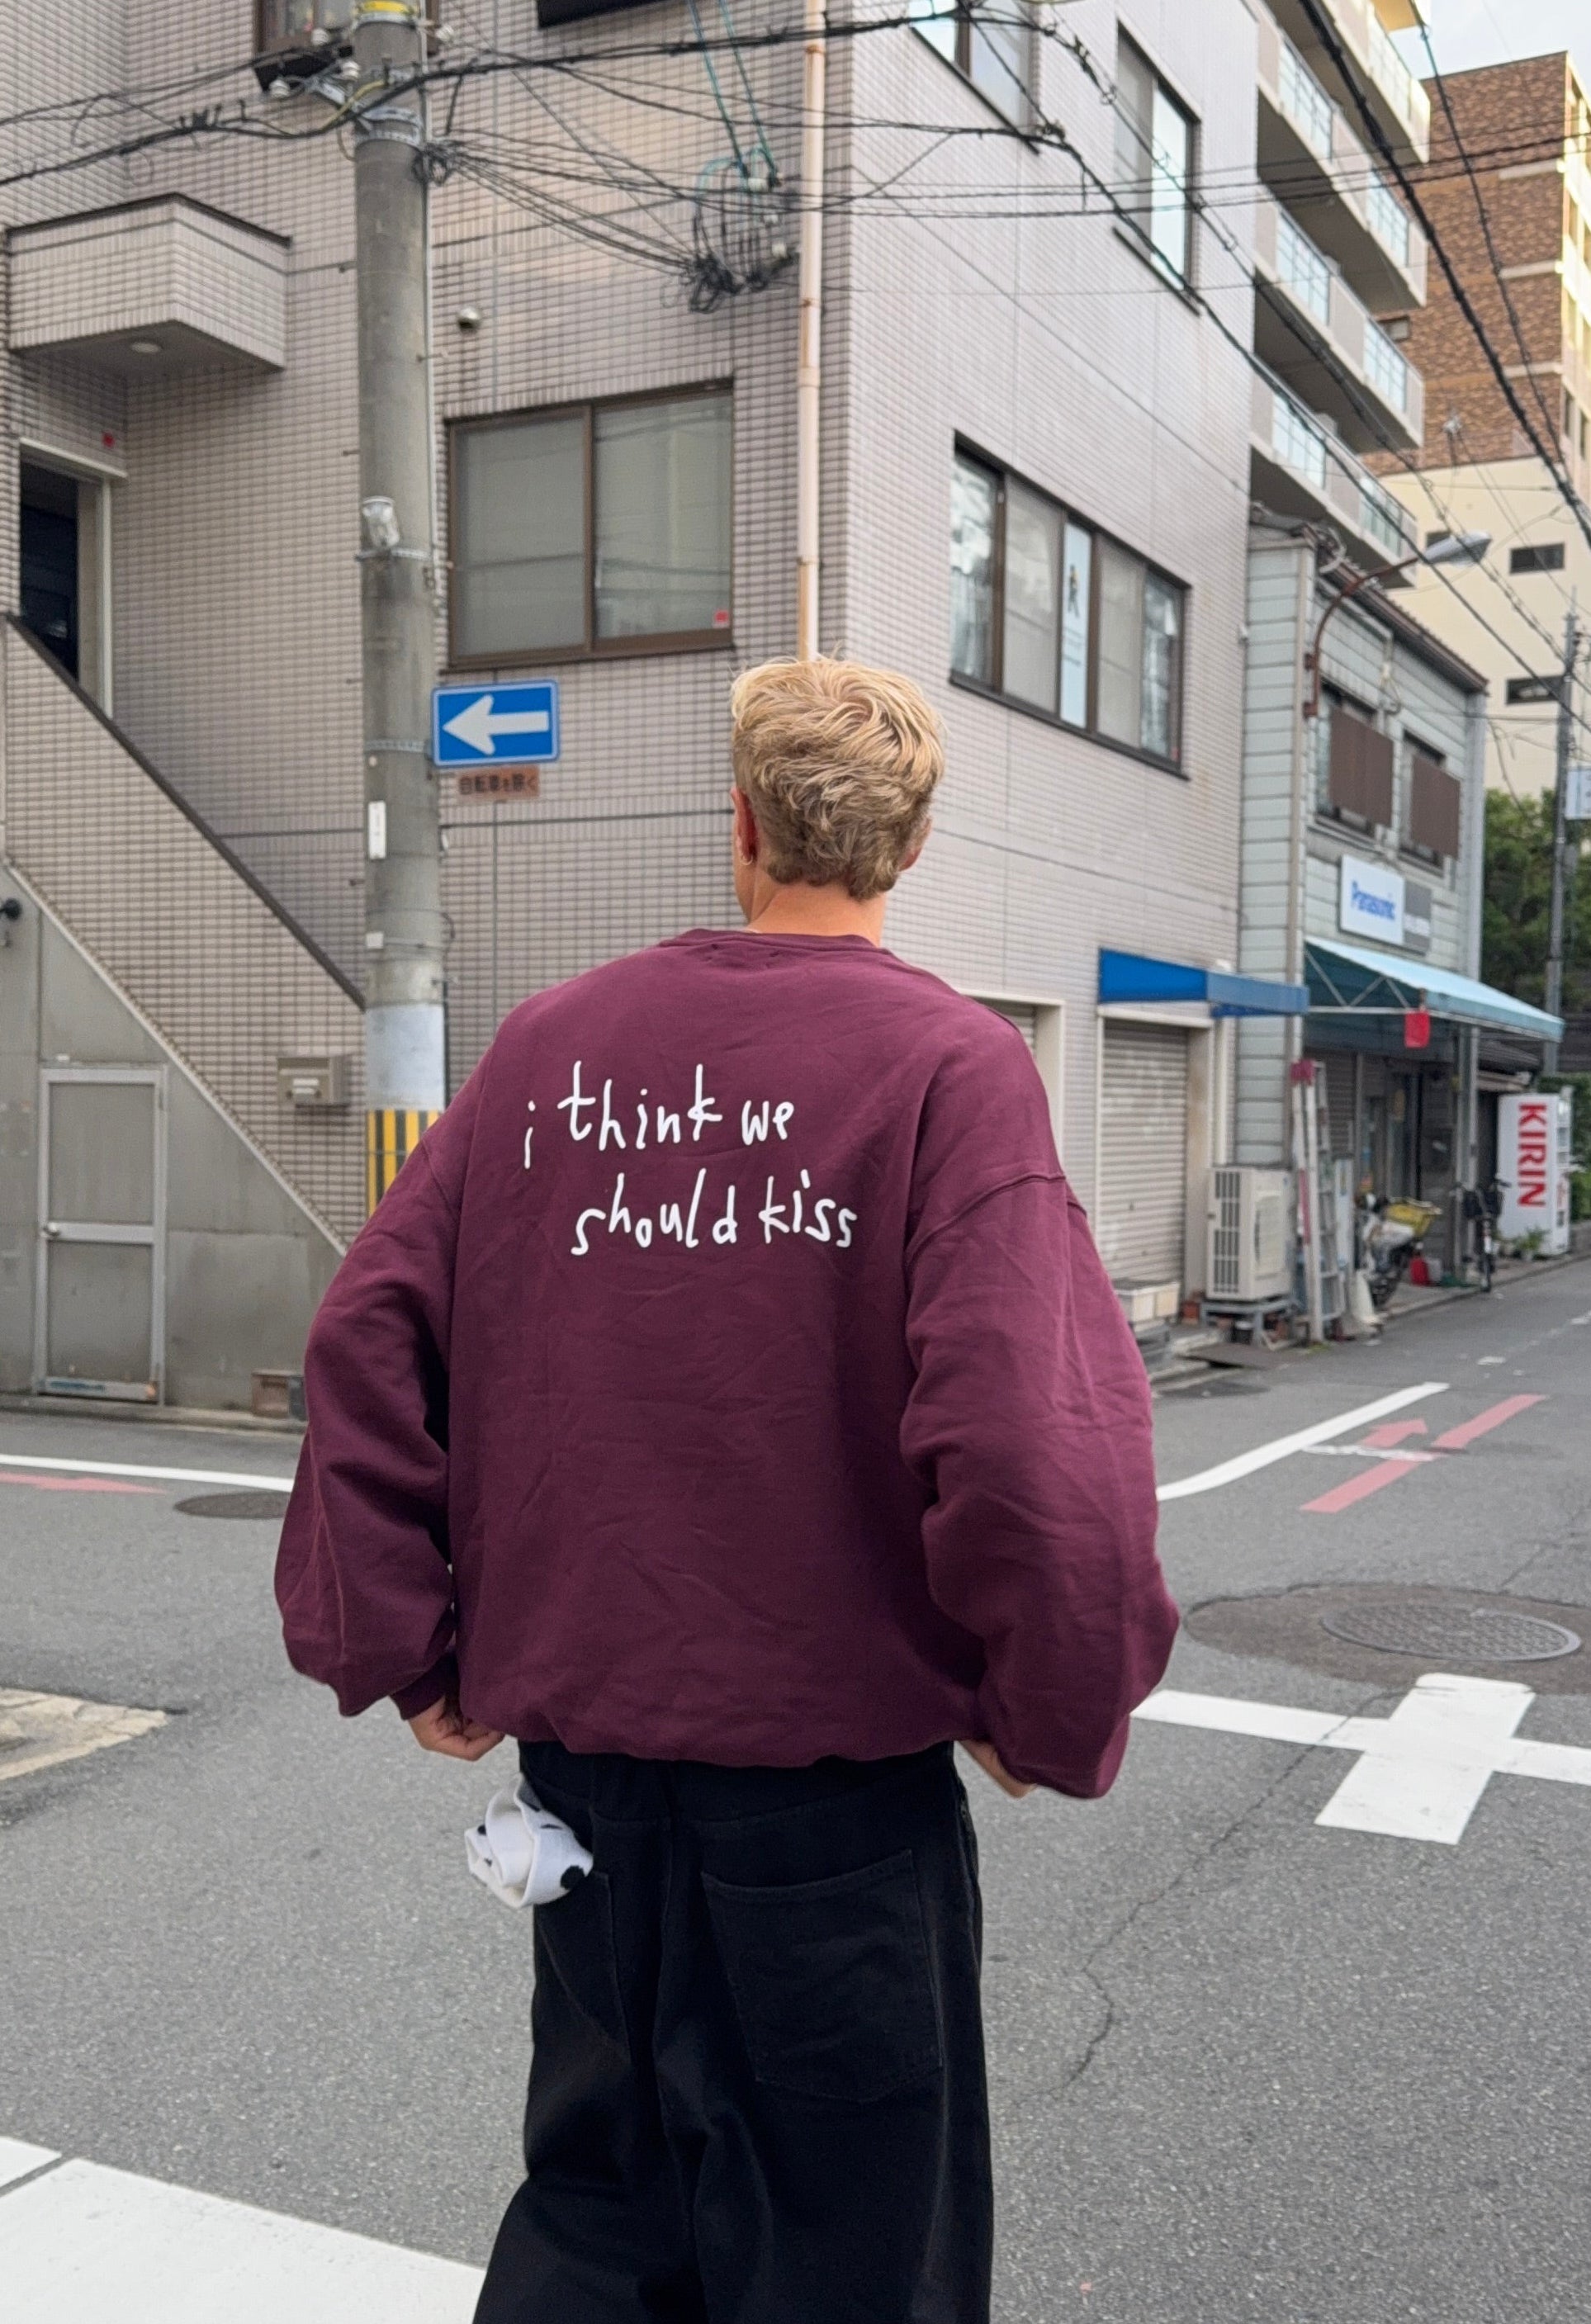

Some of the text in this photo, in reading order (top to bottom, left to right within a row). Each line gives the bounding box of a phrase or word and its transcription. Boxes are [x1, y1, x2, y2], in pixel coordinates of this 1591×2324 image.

[523, 1059, 795, 1170] i think we
[1517, 1102, 1548, 1208] KIRIN
[570, 1167, 858, 1257] should kiss
